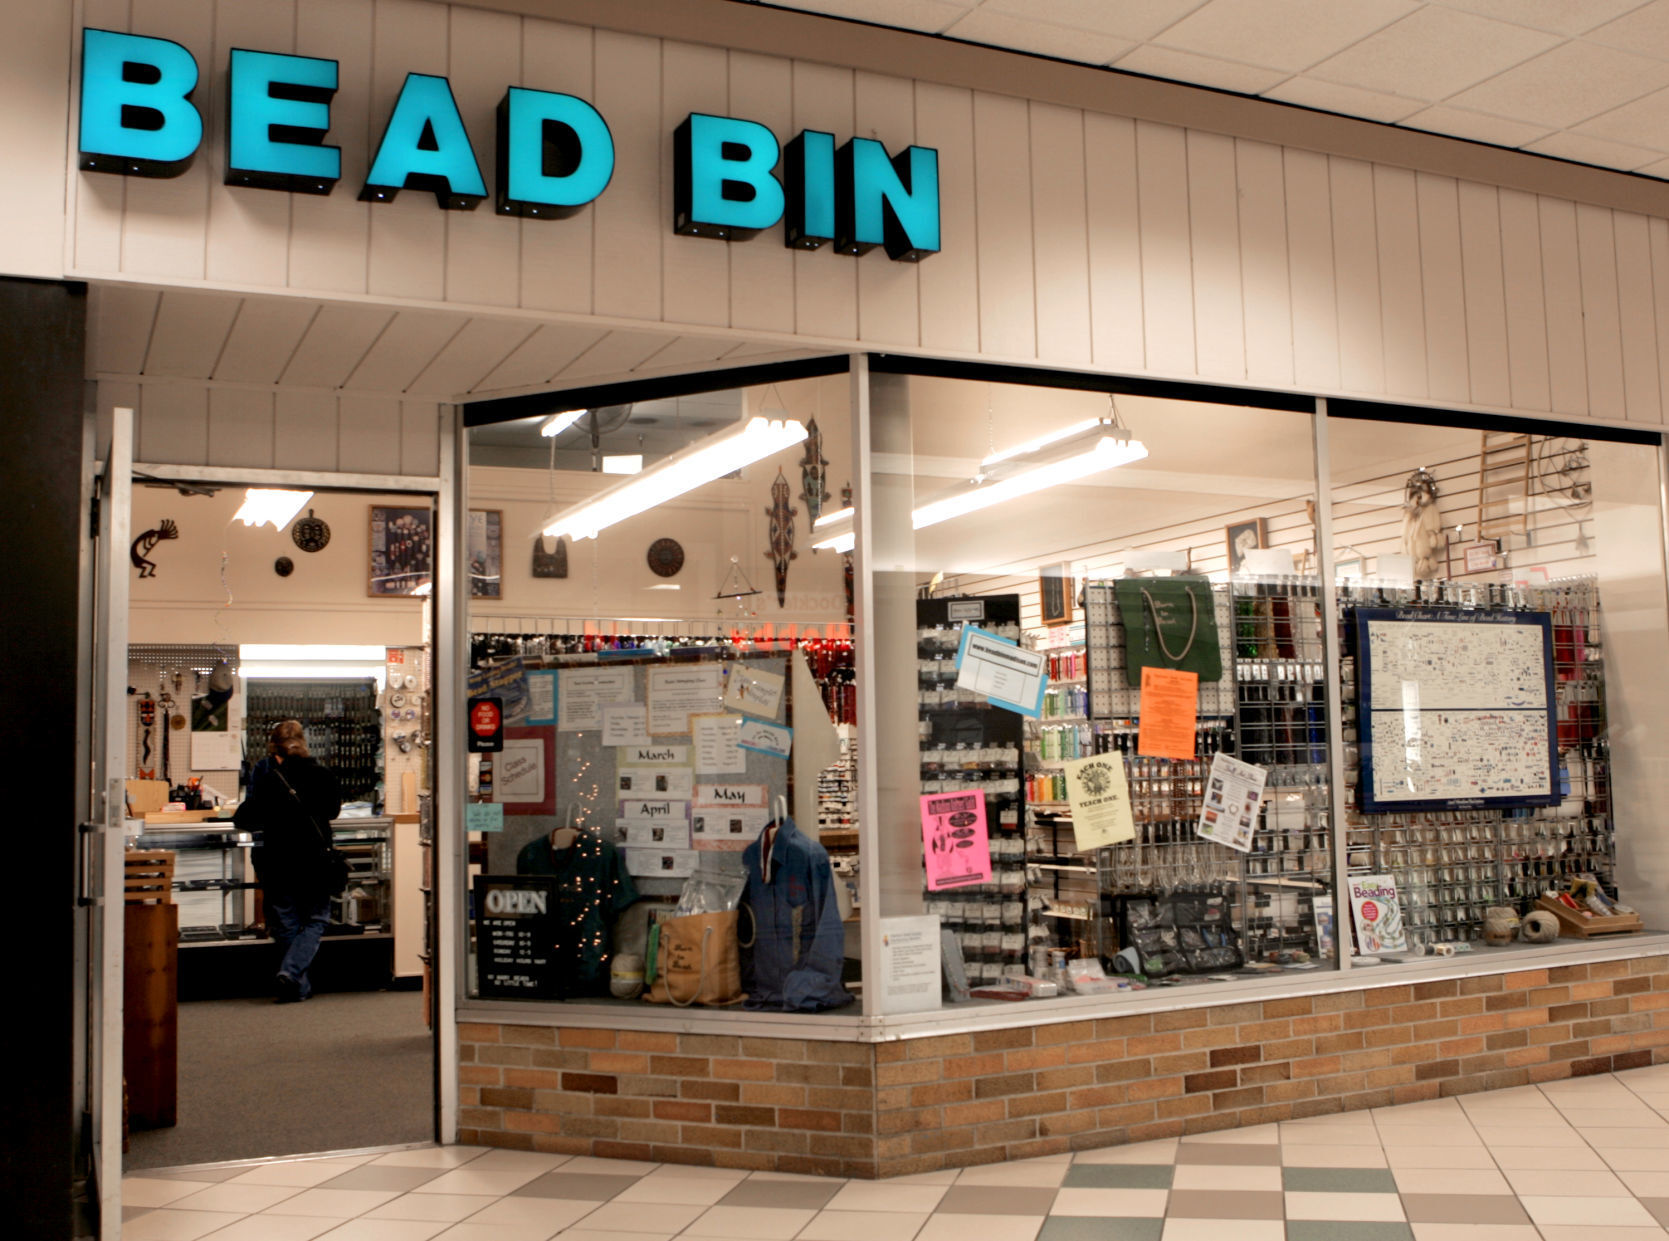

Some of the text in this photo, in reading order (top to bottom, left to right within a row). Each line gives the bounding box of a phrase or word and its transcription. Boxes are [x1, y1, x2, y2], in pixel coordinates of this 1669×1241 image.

[79, 27, 942, 256] BEAD BIN
[638, 749, 675, 761] March
[504, 756, 527, 772] Class
[1077, 761, 1113, 780] EACH ONE
[500, 763, 538, 786] Schedule
[714, 788, 746, 804] May
[1079, 798, 1103, 808] TEACH
[640, 802, 671, 818] April
[1353, 885, 1396, 900] Beading
[486, 889, 548, 914] OPEN
